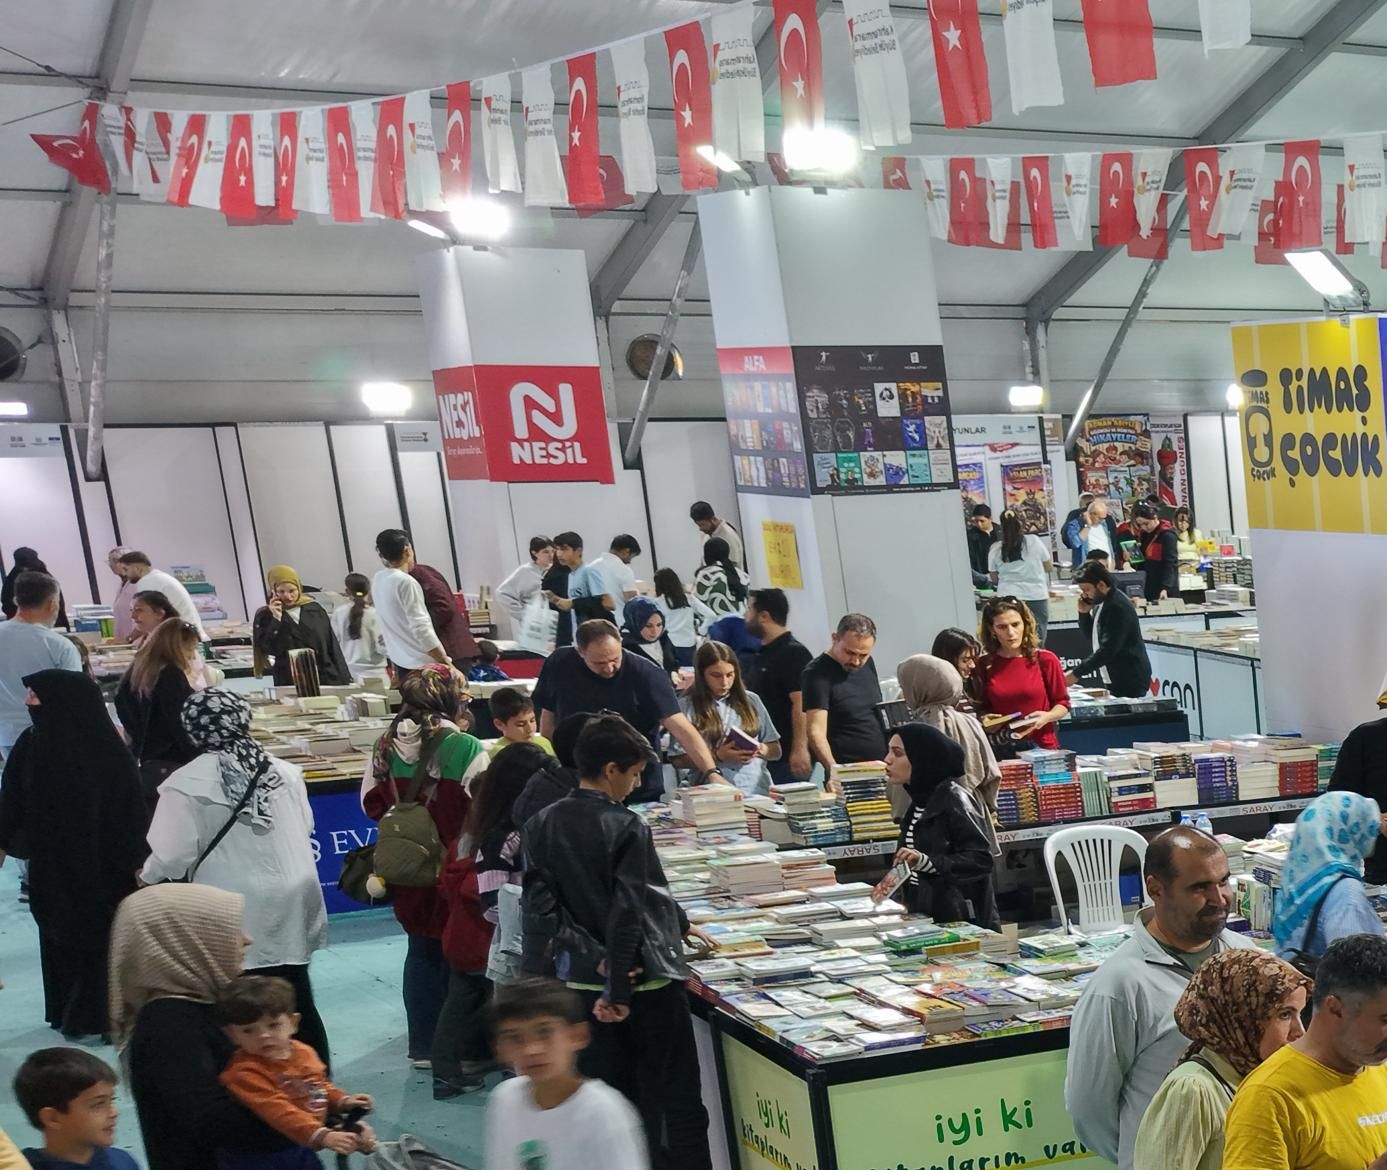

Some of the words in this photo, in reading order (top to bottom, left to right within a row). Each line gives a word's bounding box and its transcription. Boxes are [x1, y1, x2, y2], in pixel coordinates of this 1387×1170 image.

[743, 355, 767, 372] ALFA
[1280, 432, 1383, 488] ÇOCUK
[841, 844, 881, 858] SARAY
[755, 1091, 775, 1129] iyi
[776, 1108, 791, 1140] ki
[934, 1108, 984, 1146] iyi
[1000, 1098, 1035, 1133] ki
